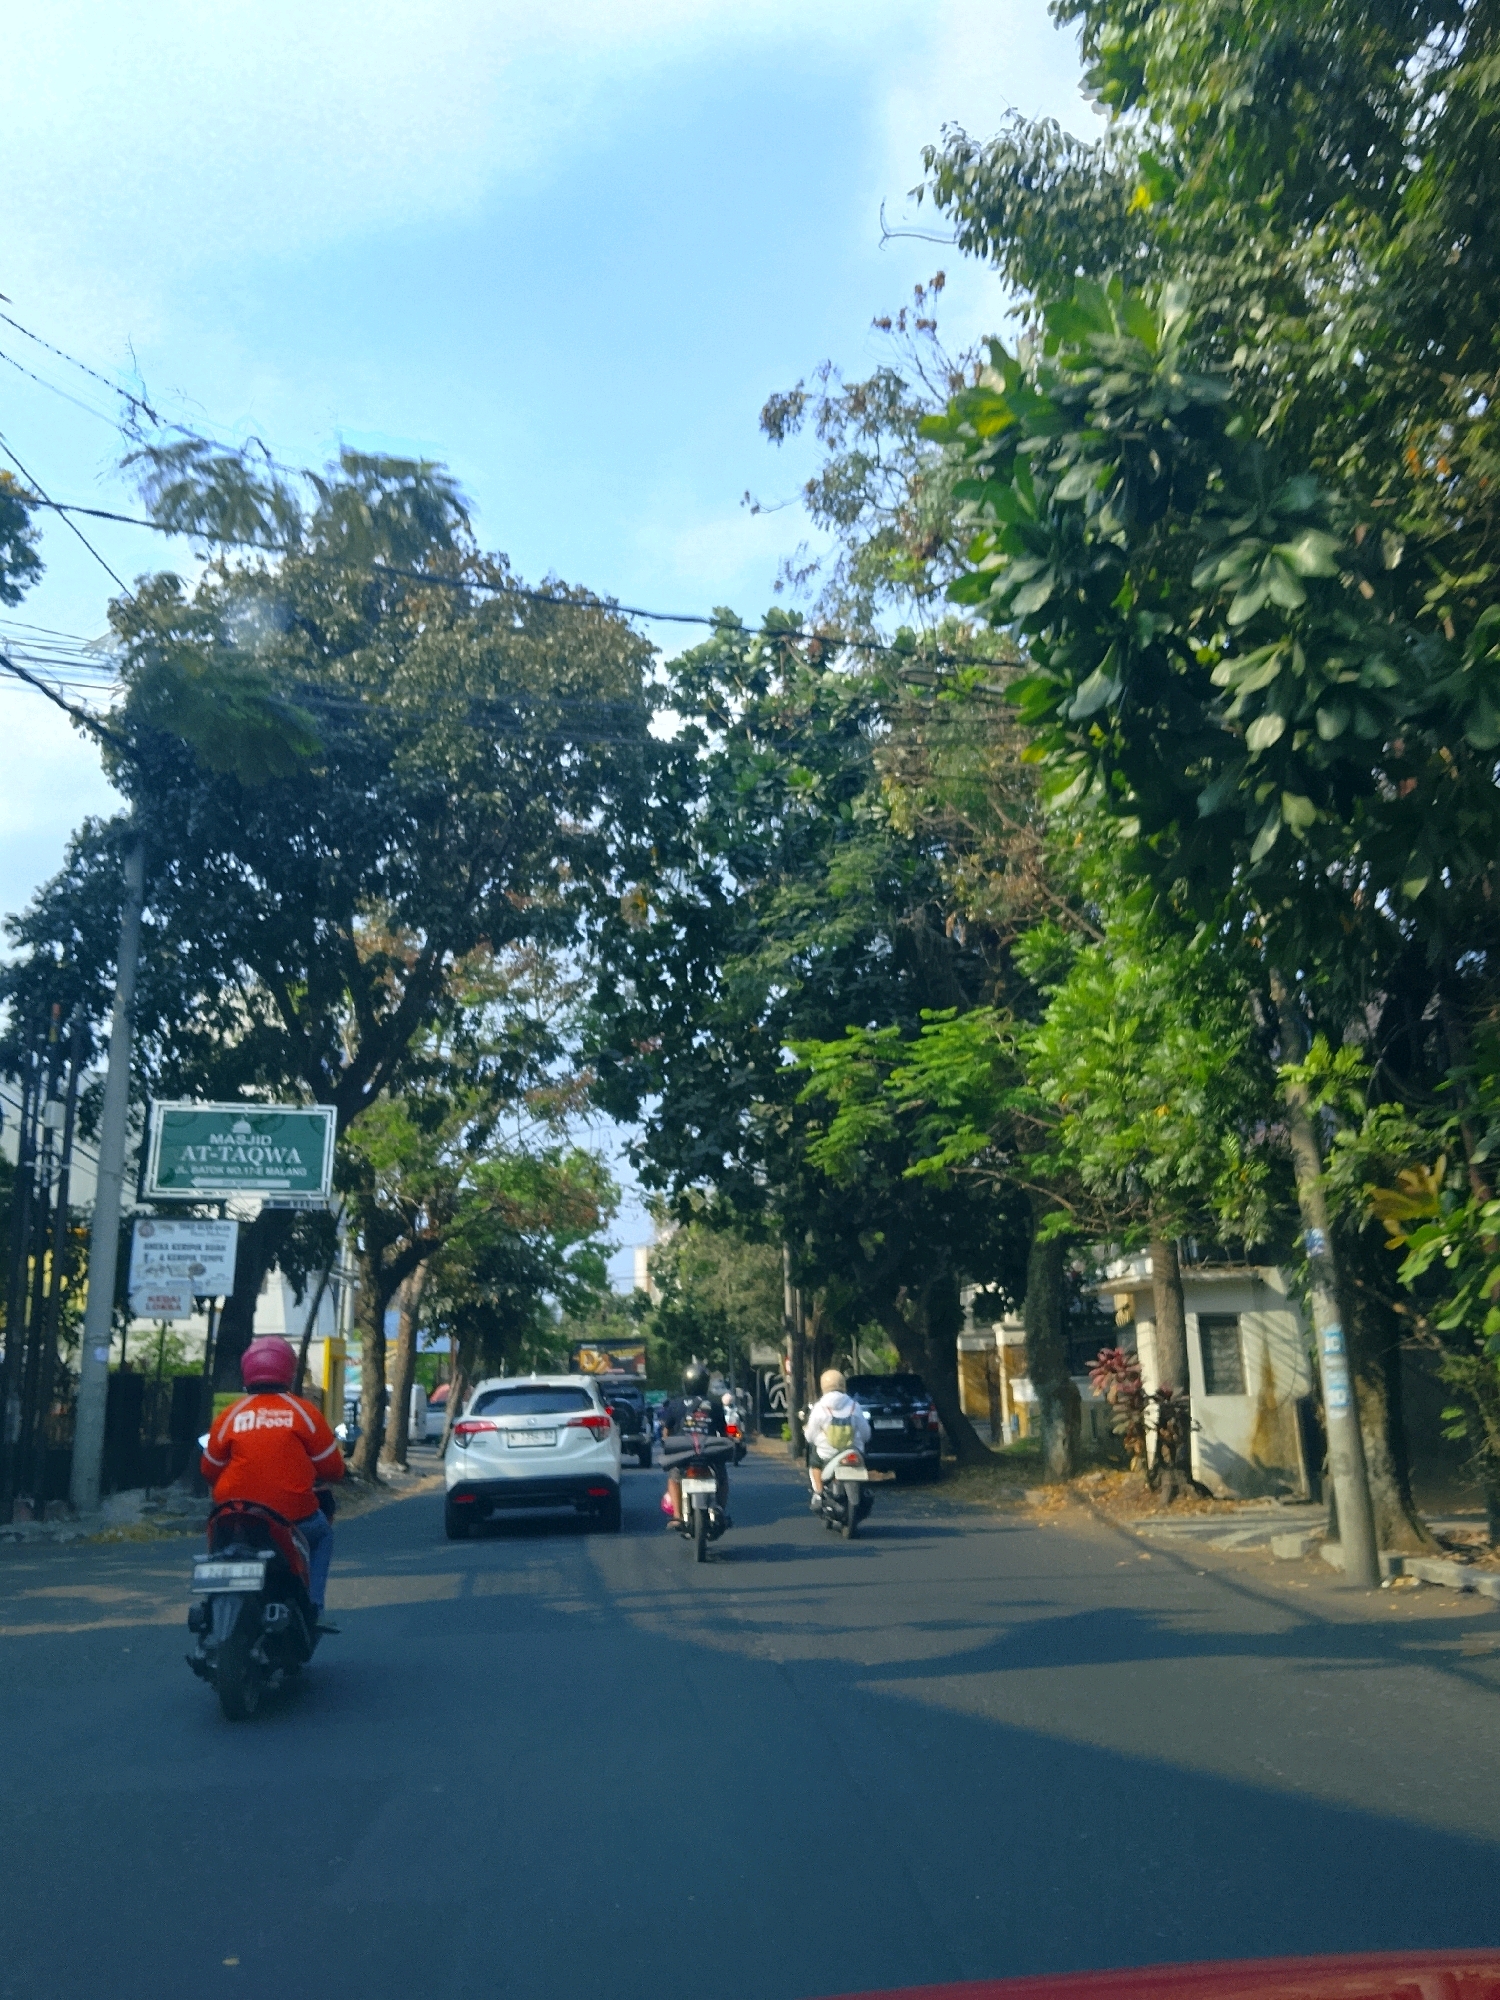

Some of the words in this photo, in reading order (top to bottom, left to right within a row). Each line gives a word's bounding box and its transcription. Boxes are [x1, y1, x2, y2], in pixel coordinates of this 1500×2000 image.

[209, 1133, 272, 1145] MASJID
[180, 1145, 302, 1166] AT-TAQWA
[265, 1167, 307, 1176] MALANG
[256, 1415, 293, 1429] Food
